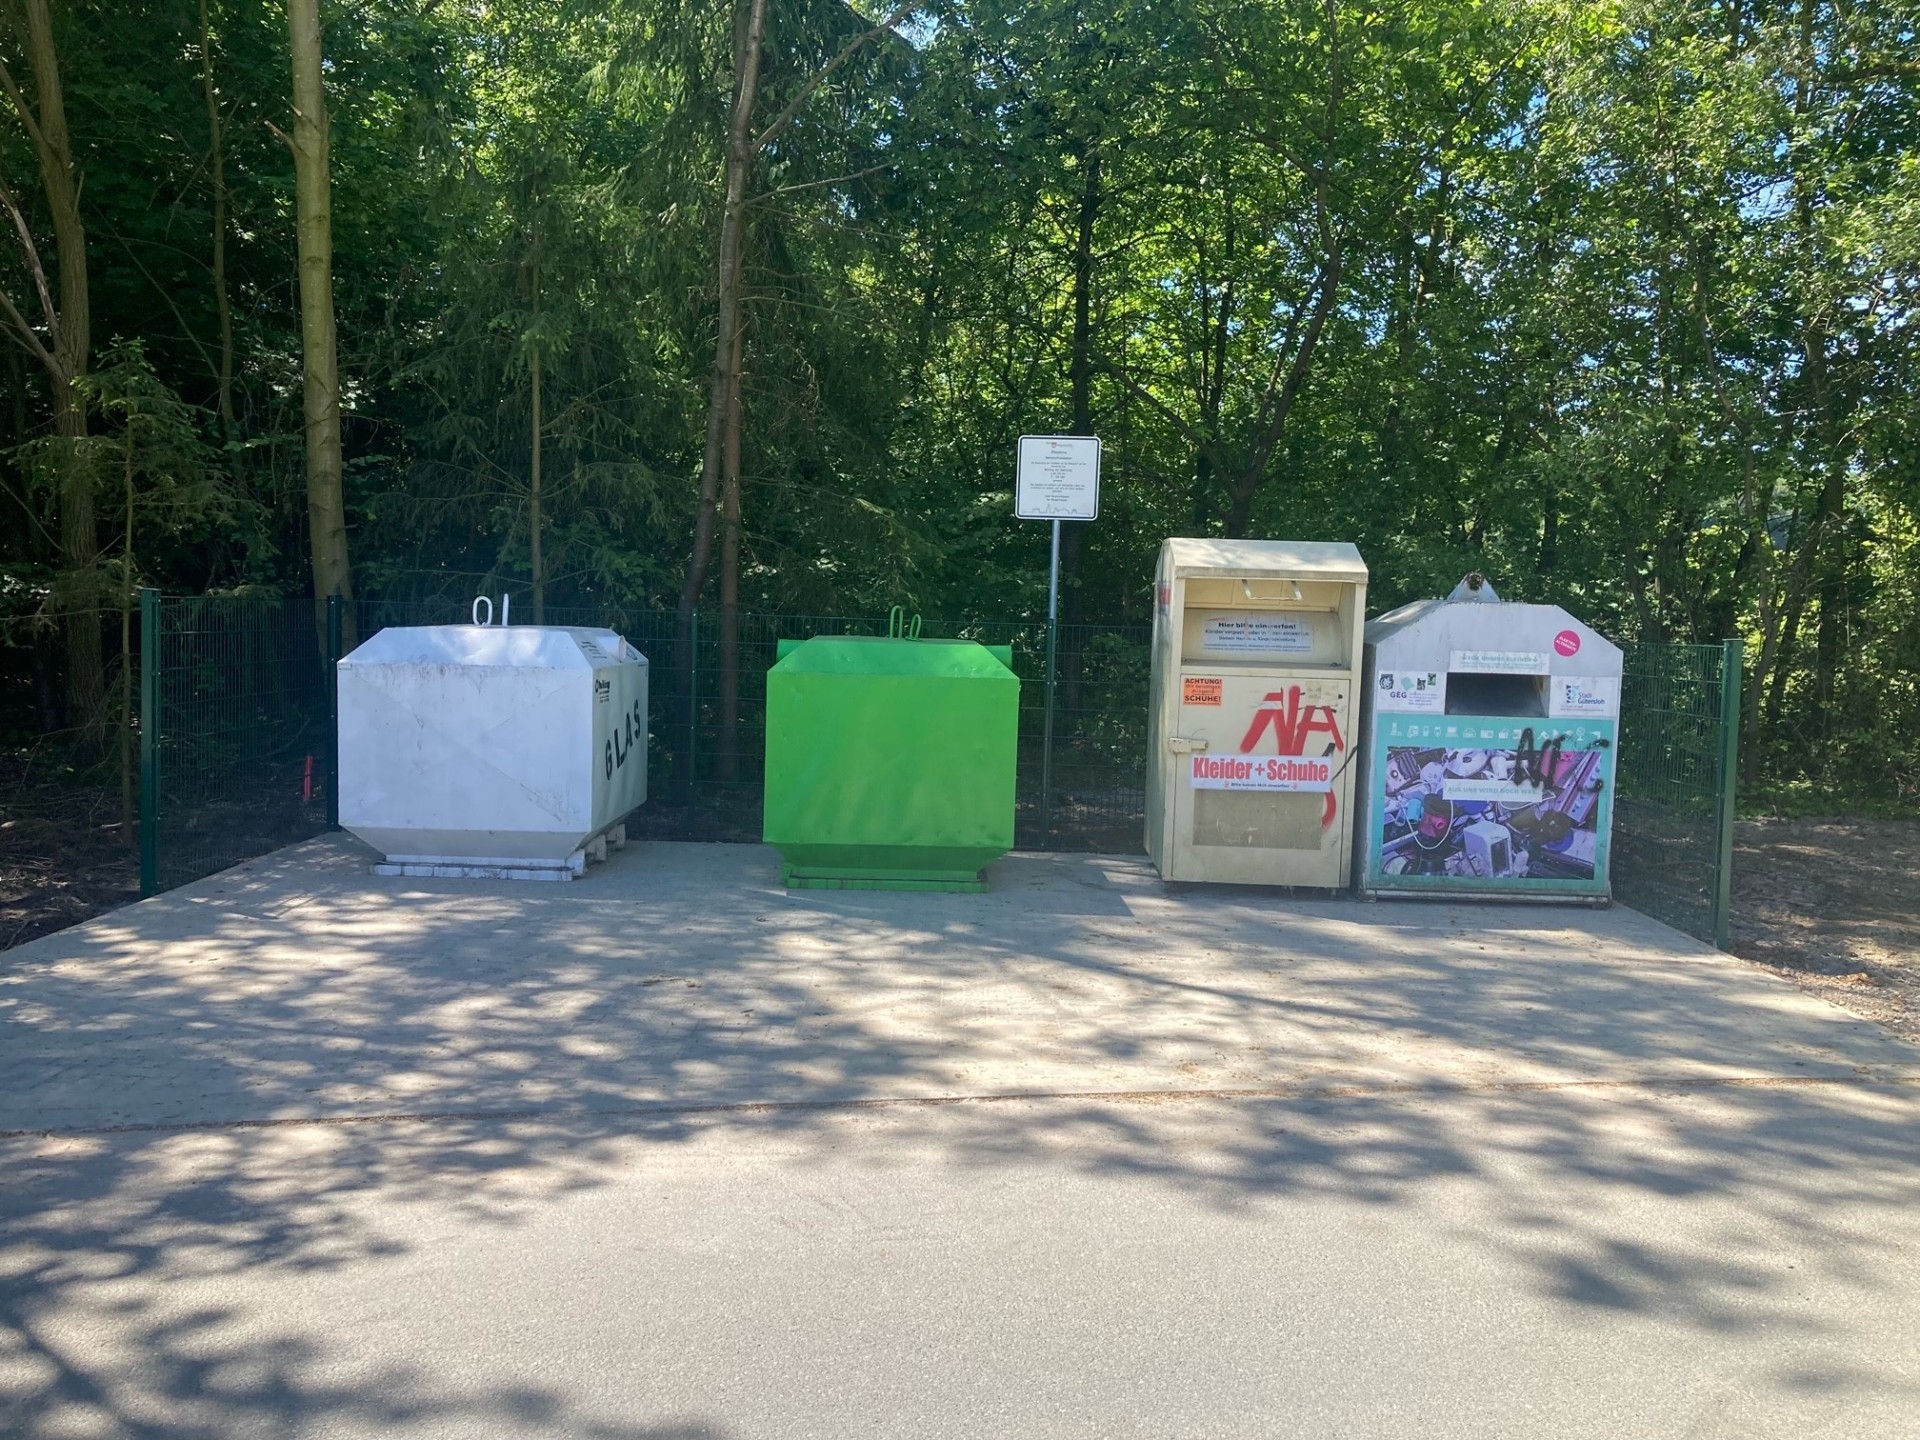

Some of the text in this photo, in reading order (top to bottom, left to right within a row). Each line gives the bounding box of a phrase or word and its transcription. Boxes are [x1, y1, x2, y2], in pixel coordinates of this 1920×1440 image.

[605, 699, 641, 781] GLAS
[1194, 757, 1329, 781] Kleider + Schuhe
